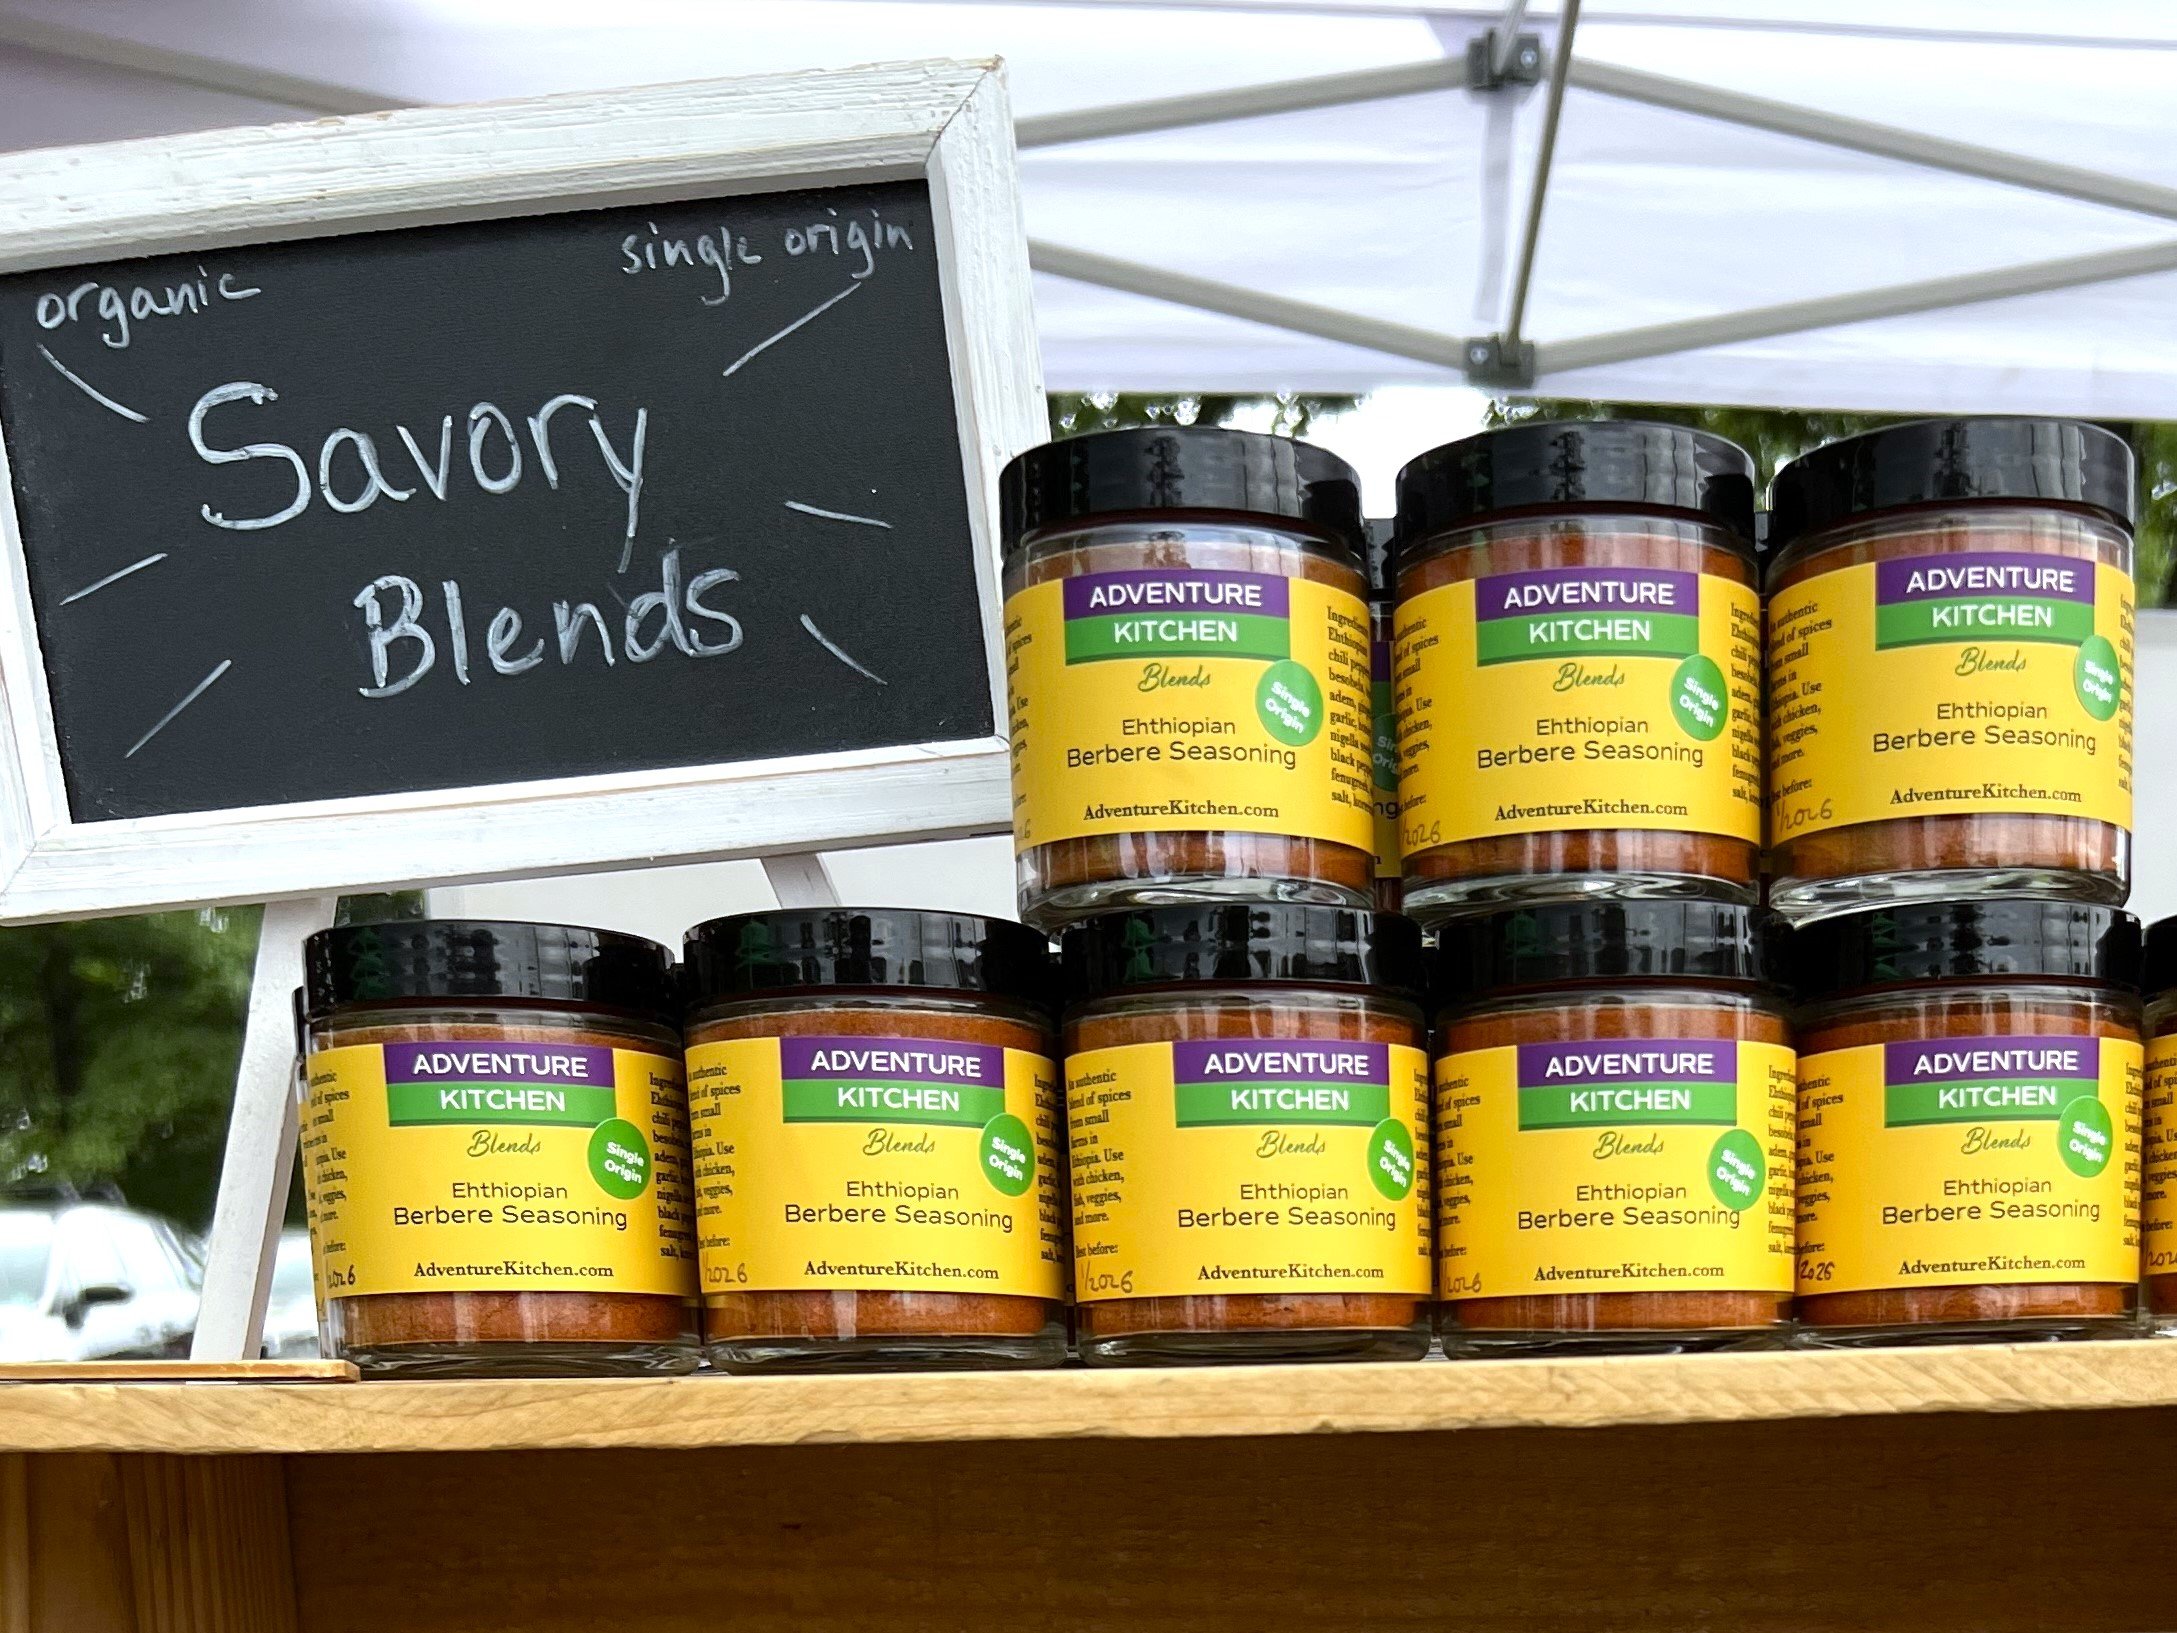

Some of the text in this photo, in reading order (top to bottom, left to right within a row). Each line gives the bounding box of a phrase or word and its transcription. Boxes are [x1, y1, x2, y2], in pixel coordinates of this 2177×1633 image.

[621, 207, 915, 306] single origin
[35, 270, 261, 349] organic
[187, 381, 649, 575] Savory
[1906, 567, 2075, 593] ADVENTURE
[1089, 582, 1263, 609] ADVENTURE
[1503, 582, 1675, 610] ADVENTURE
[354, 537, 743, 699] Blends
[1932, 604, 2053, 629] KITCHEN
[1113, 619, 1238, 644] KITCHEN
[1529, 619, 1652, 644] KITCHEN
[1955, 647, 2027, 677] Blends
[1137, 663, 1211, 693] Blends
[1552, 663, 1625, 692] Blends
[1801, 680, 1821, 696] Use
[1271, 681, 1312, 719] Single
[1683, 676, 1720, 712] Single
[1265, 699, 1305, 735] Origin
[1679, 694, 1714, 729] Origin
[1937, 702, 2048, 723] Ehthiopian
[1122, 718, 1236, 738] Ehthiopian
[1536, 717, 1649, 738] Ehthiopian
[1873, 725, 2096, 755] Berbere Seasoning
[1067, 741, 1297, 770] Berbere Seasoning
[1477, 741, 1703, 769] Berbere Seasoning
[1890, 783, 2082, 805] AdventureKitchen.com
[1083, 800, 1279, 822] AdventureKitchen.com
[1494, 800, 1688, 822] AdventureKitchen.com
[413, 1054, 589, 1079] ADVENTURE
[811, 1050, 981, 1078] ADVENTURE
[1204, 1052, 1369, 1077] ADVENTURE
[1545, 1053, 1713, 1078] ADVENTURE
[1913, 1050, 2079, 1075] ADVENTURE
[440, 1089, 566, 1113] KITCHEN
[837, 1087, 960, 1112] KITCHEN
[1098, 1088, 1131, 1107] spices
[1231, 1089, 1349, 1112] KITCHEN
[1570, 1089, 1690, 1113] KITCHEN
[1939, 1086, 2056, 1109] KITCHEN
[1085, 1109, 1109, 1126] small
[466, 1130, 542, 1158] Blends
[716, 1141, 735, 1155] Use
[862, 1128, 935, 1156] Blends
[991, 1136, 1026, 1164] Single
[1256, 1131, 1326, 1159] Blends
[1593, 1131, 1665, 1160] Blends
[1960, 1126, 2031, 1155] Blends
[606, 1141, 645, 1167] Single
[1104, 1149, 1124, 1162] Use
[1720, 1148, 1756, 1180] Single
[603, 1159, 642, 1185] Origin
[988, 1154, 1024, 1181] Origin
[452, 1182, 568, 1203] Ehthiopian
[846, 1180, 959, 1202] Ehthiopian
[1241, 1183, 1348, 1204] Ehthiopian
[1576, 1184, 1687, 1204] Ehthiopian
[1716, 1166, 1750, 1197] Origin
[1944, 1178, 2052, 1198] Ehthiopian
[394, 1204, 628, 1231] Berbere Seasoning
[785, 1204, 1013, 1233] Berbere Seasoning
[1178, 1207, 1396, 1231] Berbere Seasoning
[1518, 1206, 1740, 1230] Berbere Seasoning
[1882, 1200, 2100, 1226] Berbere Seasoning
[413, 1261, 614, 1279] AdventureKitchen.com
[804, 1260, 999, 1280] AdventureKitchen.com
[1197, 1263, 1384, 1281] AdventureKitchen.com
[1534, 1263, 1724, 1282] AdventureKitchen.com
[1898, 1256, 2085, 1276] AdventureKitchen.com
